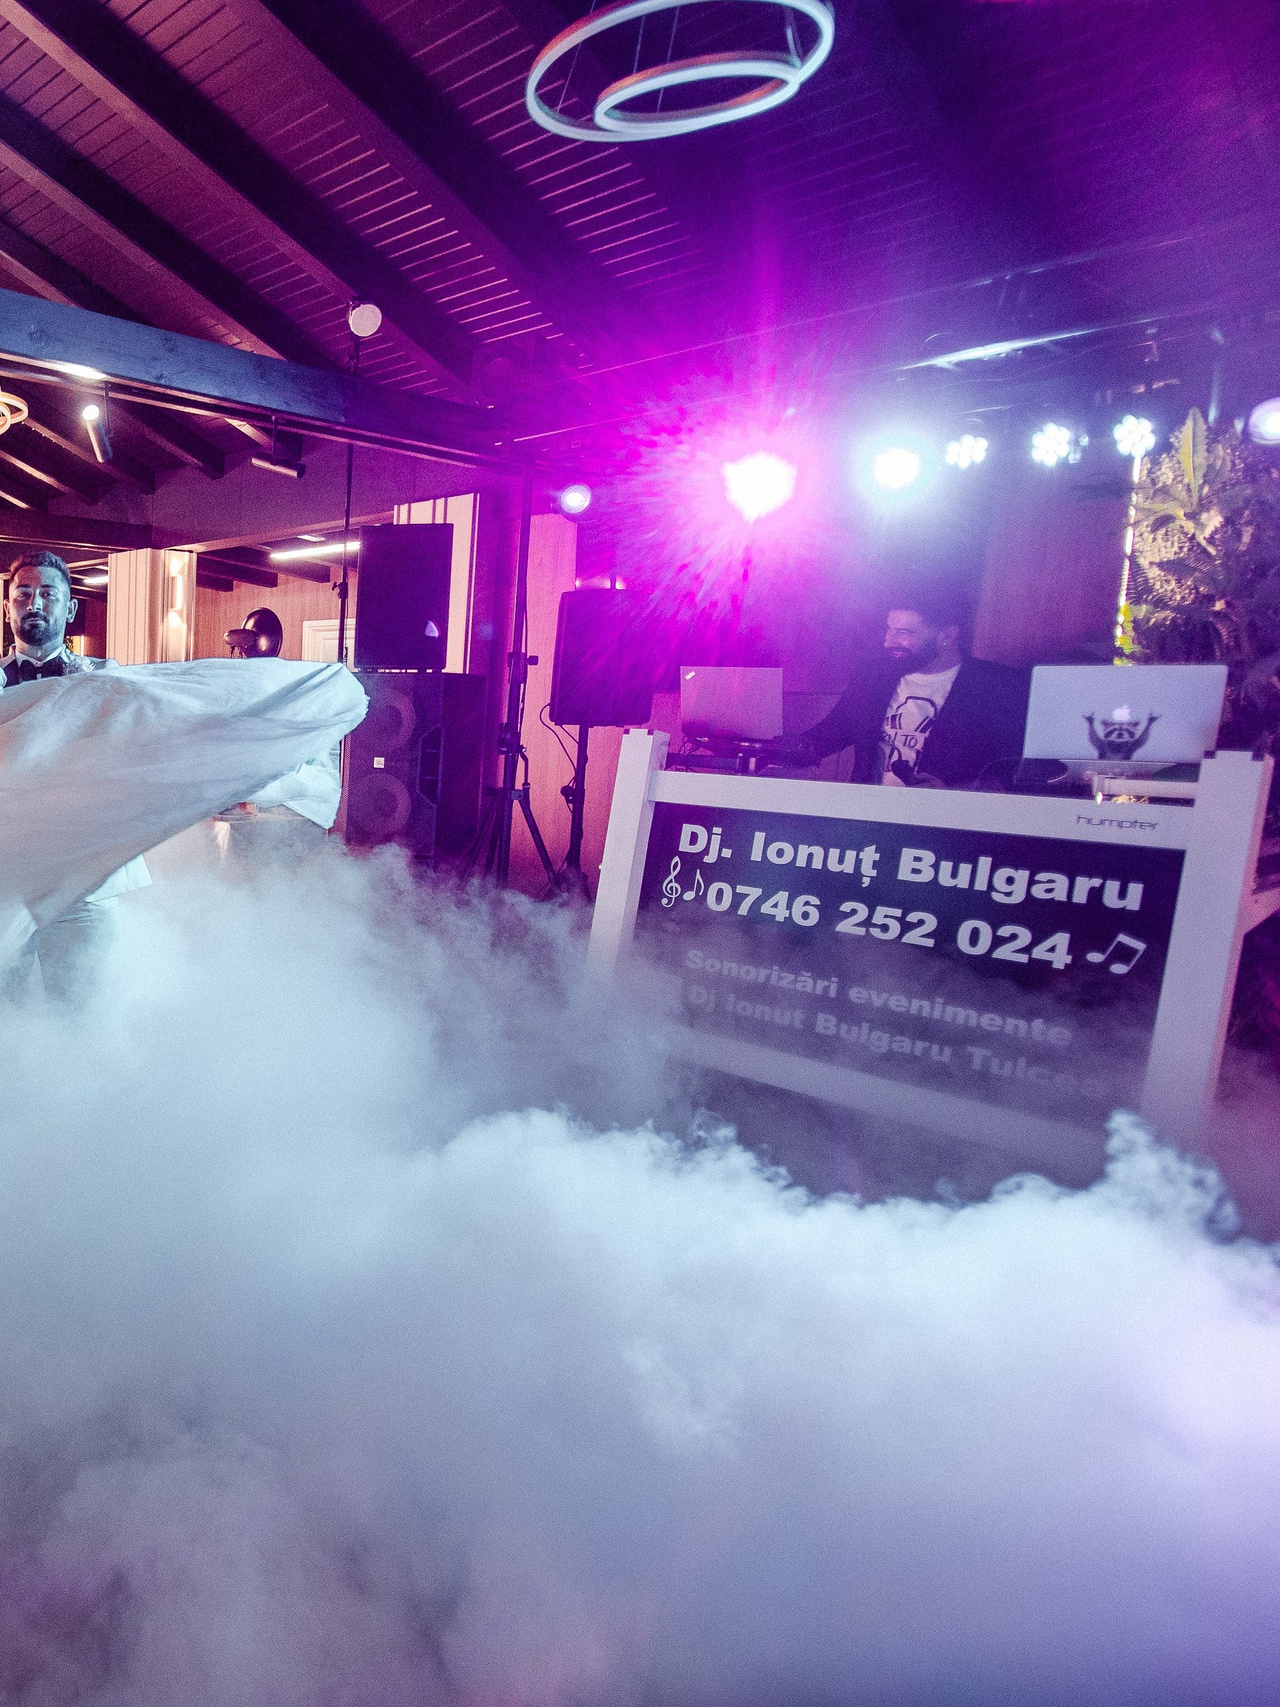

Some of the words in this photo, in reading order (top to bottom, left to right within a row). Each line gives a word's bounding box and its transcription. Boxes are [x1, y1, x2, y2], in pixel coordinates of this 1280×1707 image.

[900, 734, 918, 748] TO
[1076, 814, 1159, 831] humpter
[678, 823, 733, 864] Dj.
[750, 831, 881, 887] Ionuț
[896, 847, 1144, 911] Bulgaru
[706, 881, 821, 927] 0746
[835, 901, 938, 948] 252
[956, 919, 1073, 970] 024
[684, 949, 839, 998] Sonorizări
[848, 985, 1073, 1046] evenimente
[815, 1012, 953, 1063] Bulgaru
[967, 1045, 1108, 1100] Tulcea
